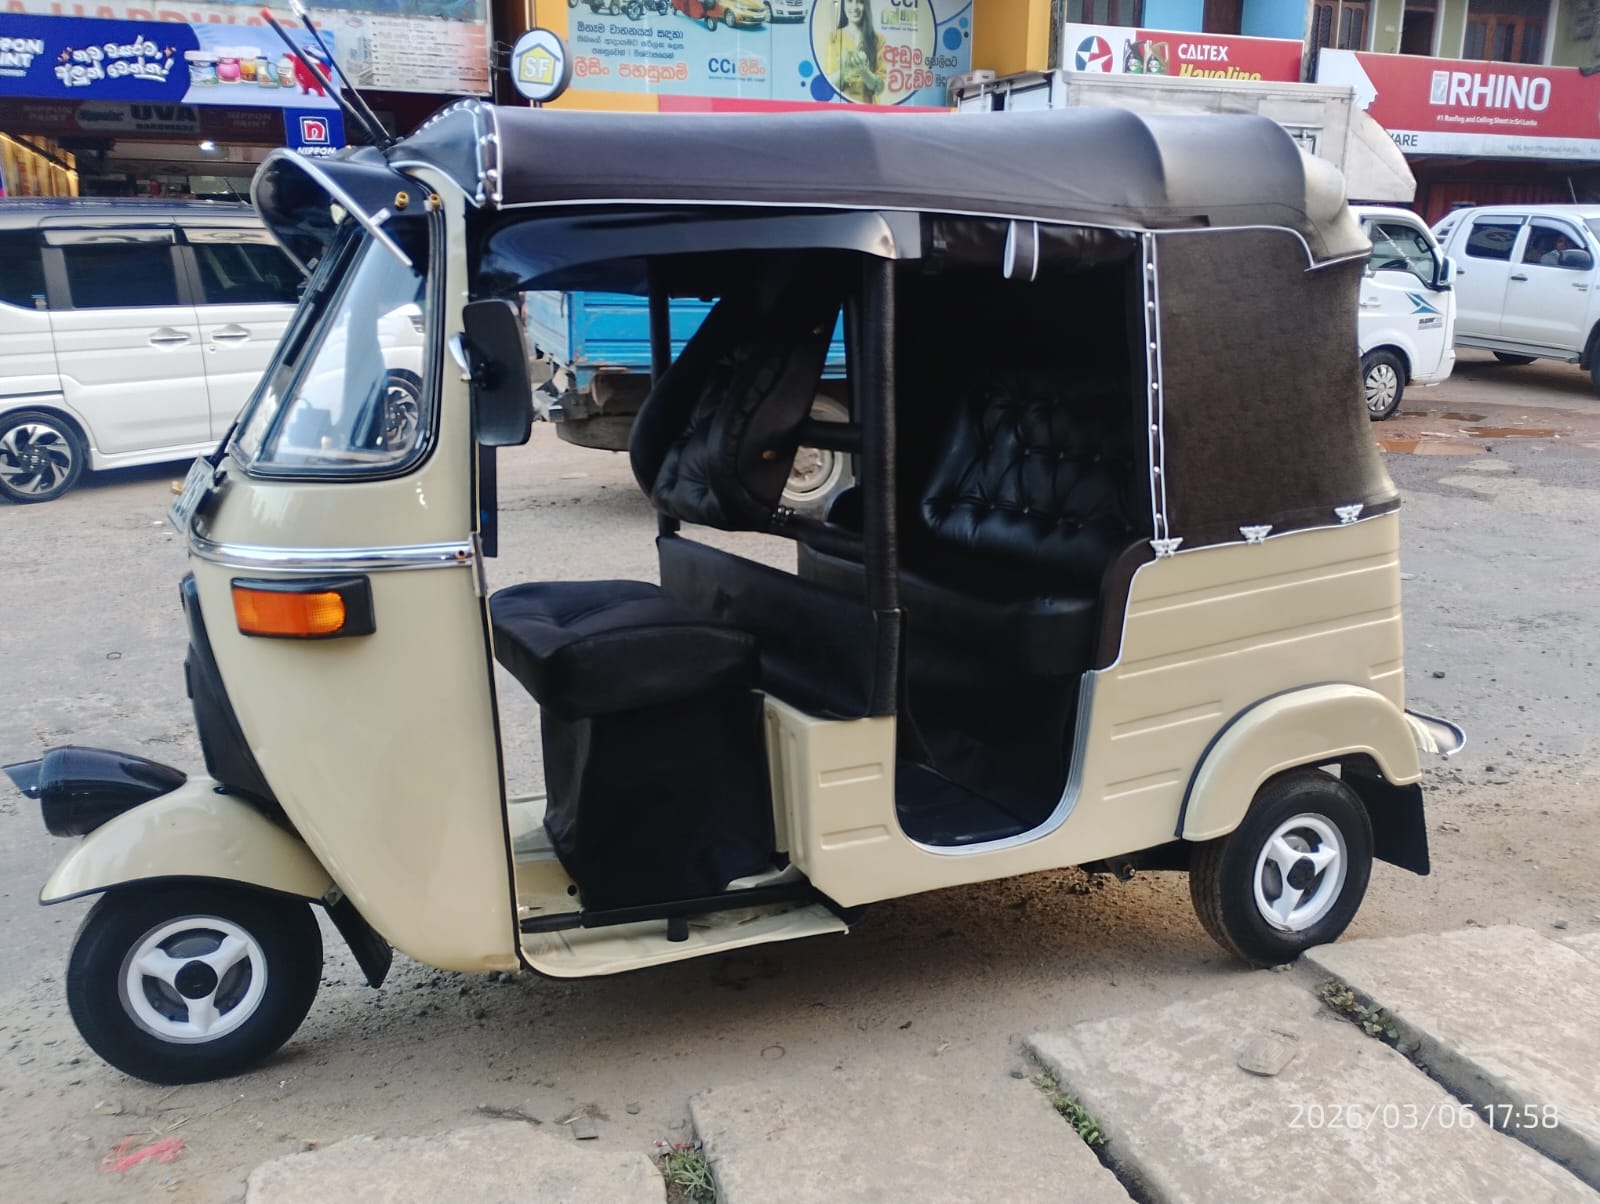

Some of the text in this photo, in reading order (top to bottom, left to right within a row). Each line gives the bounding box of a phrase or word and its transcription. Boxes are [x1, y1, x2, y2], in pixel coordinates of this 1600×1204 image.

[609, 23, 654, 37] වාහනයක්
[657, 29, 684, 40] සඳහා
[882, 44, 923, 68] අඩුම
[1178, 43, 1229, 61] CALTEX
[524, 57, 550, 77] SF
[574, 56, 688, 83] ලීසිං පහසුකම්
[887, 69, 934, 93] වැඩිම
[1449, 71, 1551, 111] RHINO
[130, 103, 197, 121] UVA
[1391, 133, 1419, 147] ARE
